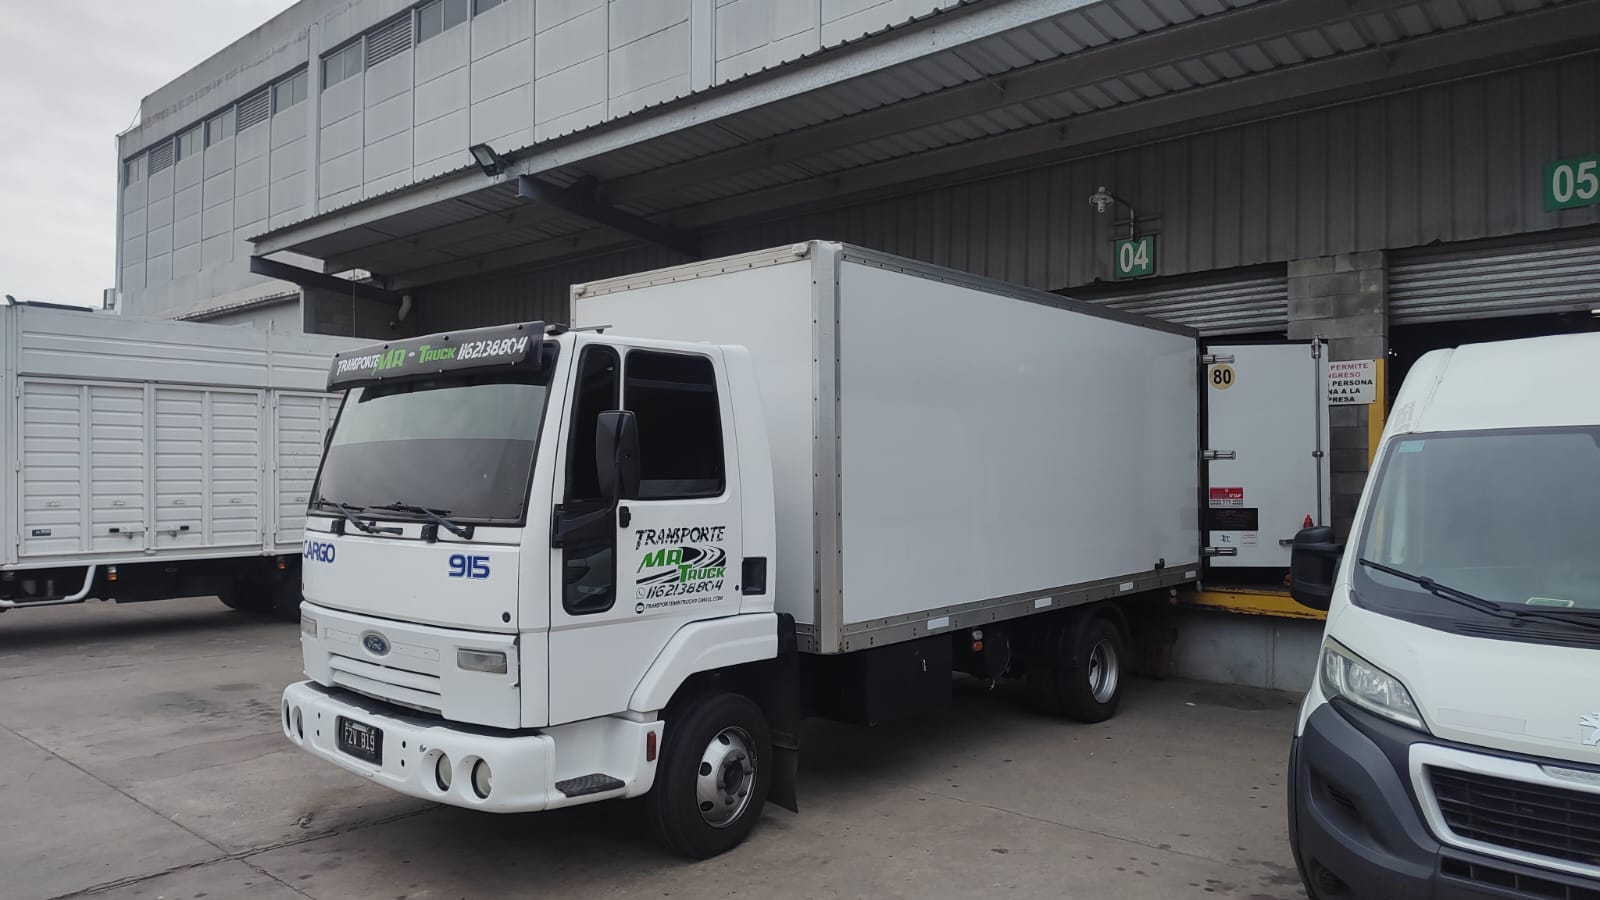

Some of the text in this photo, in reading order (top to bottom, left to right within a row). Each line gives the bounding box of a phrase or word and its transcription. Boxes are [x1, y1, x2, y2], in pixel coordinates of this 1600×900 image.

[1552, 160, 1599, 203] 05
[1120, 240, 1149, 273] 04
[336, 354, 380, 376] TRANSPORTE
[456, 336, 529, 361] 1162138804
[1330, 362, 1369, 370] PERMITE
[1213, 368, 1232, 385] 80
[1332, 379, 1373, 387] PERSONA
[635, 525, 726, 550] TRANSPORTE
[303, 539, 336, 563] CARGO
[448, 553, 491, 579] 915
[645, 579, 724, 600] 1162138804
[360, 732, 375, 752] 819
